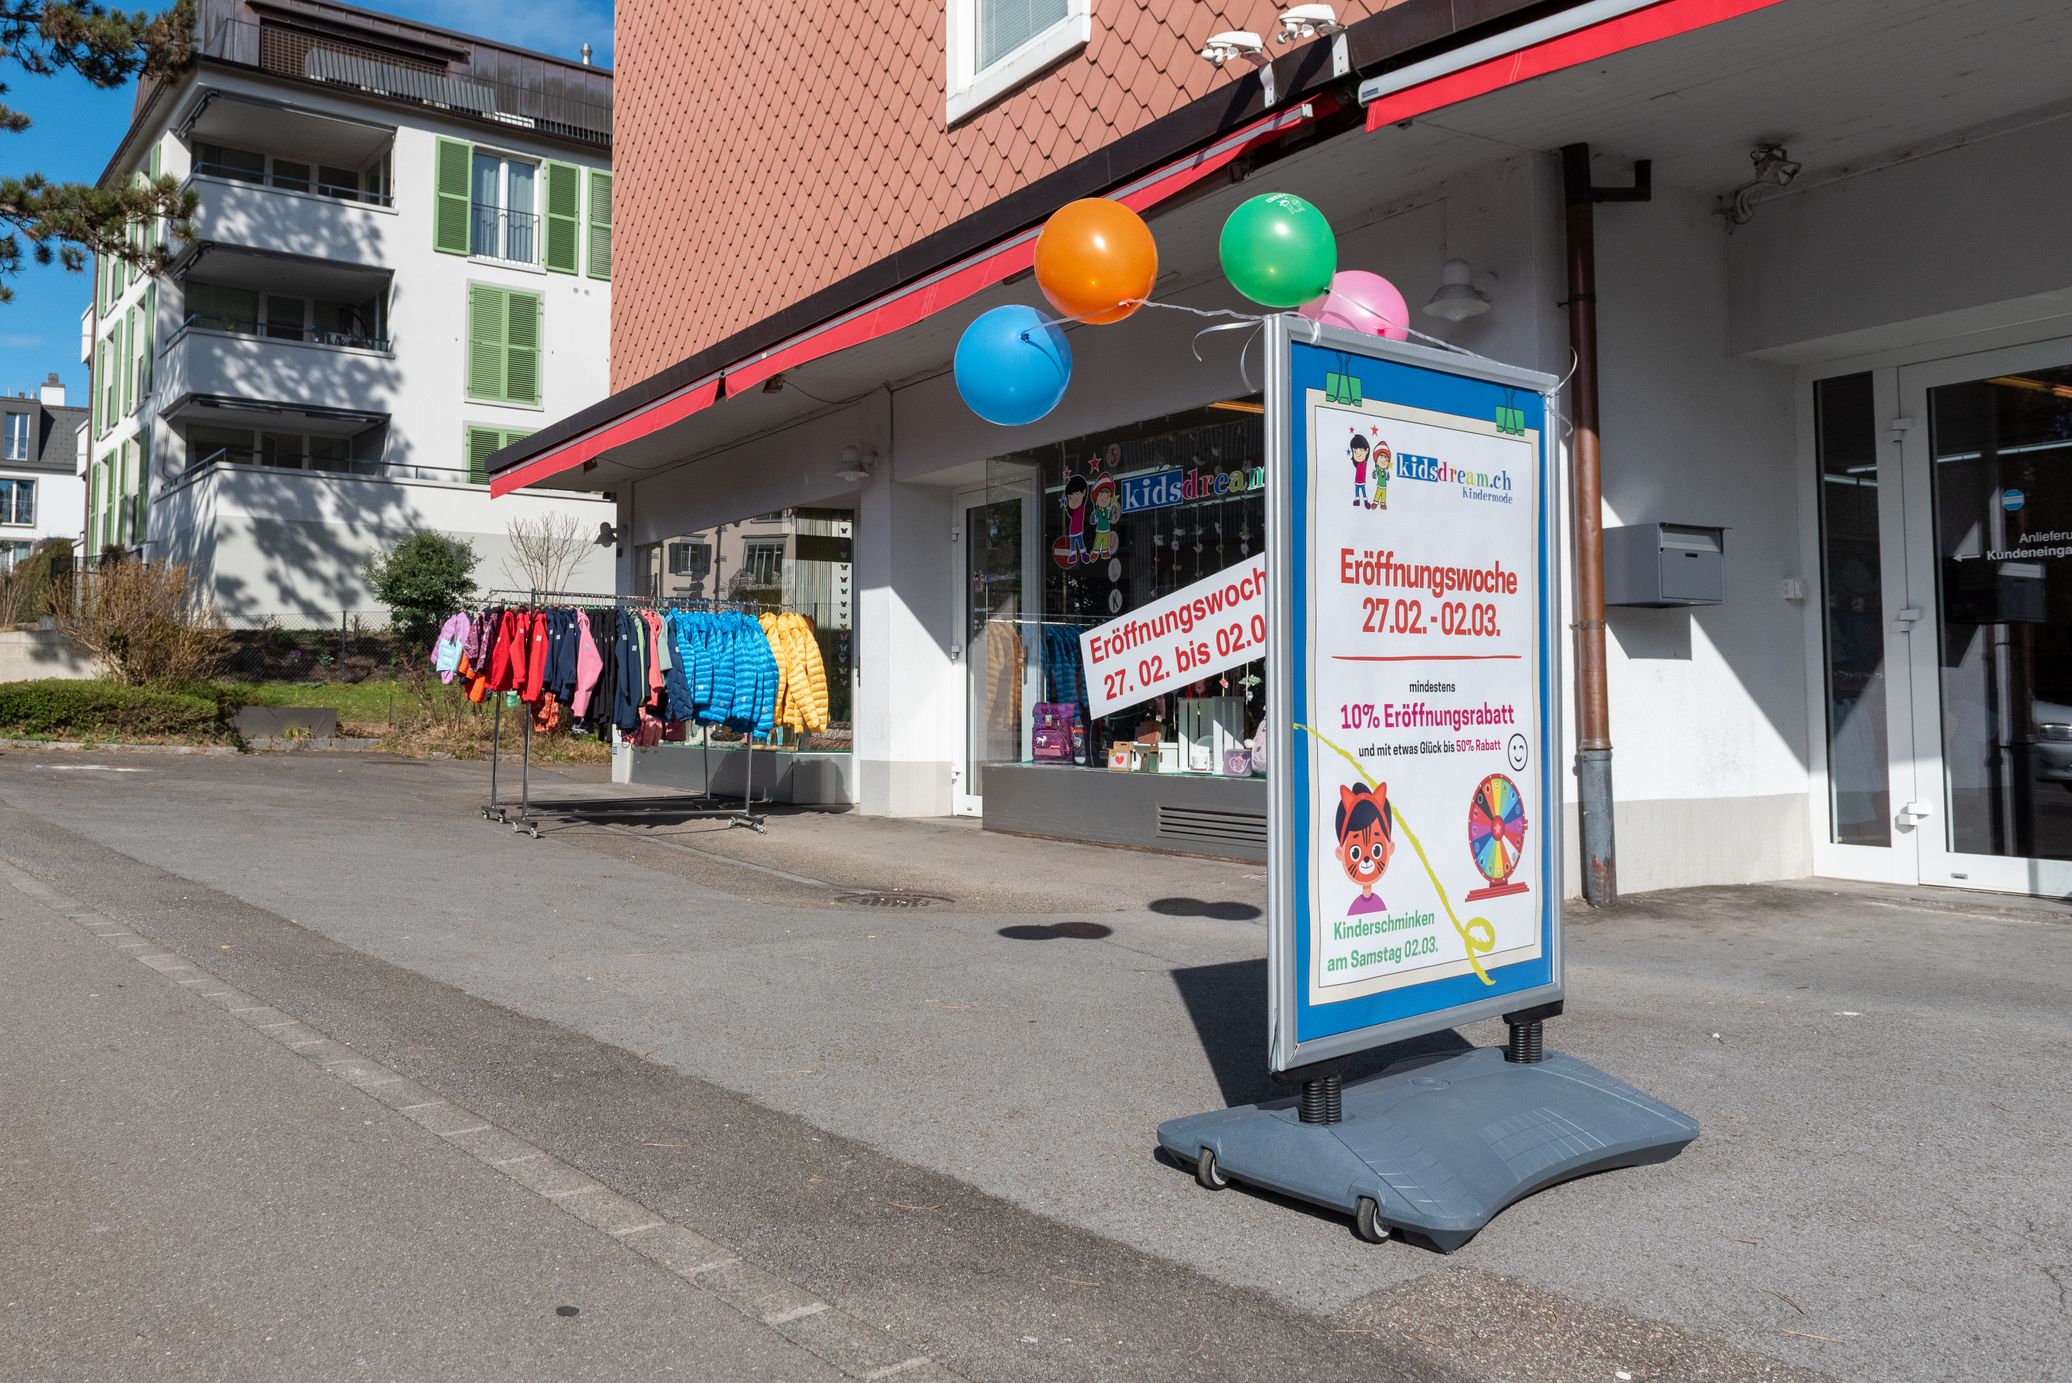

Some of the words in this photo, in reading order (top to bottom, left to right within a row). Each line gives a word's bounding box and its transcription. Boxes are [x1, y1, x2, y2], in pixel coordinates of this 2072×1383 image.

[1397, 453, 1512, 491] kidsdream.ch
[1462, 486, 1513, 504] Kindermode
[1341, 548, 1517, 598] Eröffnungswoche
[1175, 641, 1211, 673] bis
[1409, 680, 1456, 693] mindestens
[1340, 704, 1380, 729] 10%
[1384, 702, 1515, 731] Eröffnungsrabatt
[1359, 743, 1375, 757] und
[1377, 743, 1391, 756] mit
[1393, 743, 1418, 756] etwas
[1420, 740, 1442, 754] Glück
[1444, 740, 1455, 753] bis
[1456, 739, 1475, 752] 50%
[1475, 738, 1501, 751] Rabatt
[1333, 910, 1435, 940] Kinderschminken
[1327, 956, 1348, 972] am
[1350, 945, 1402, 969] Samstag
[1404, 936, 1438, 958] 02.03.
